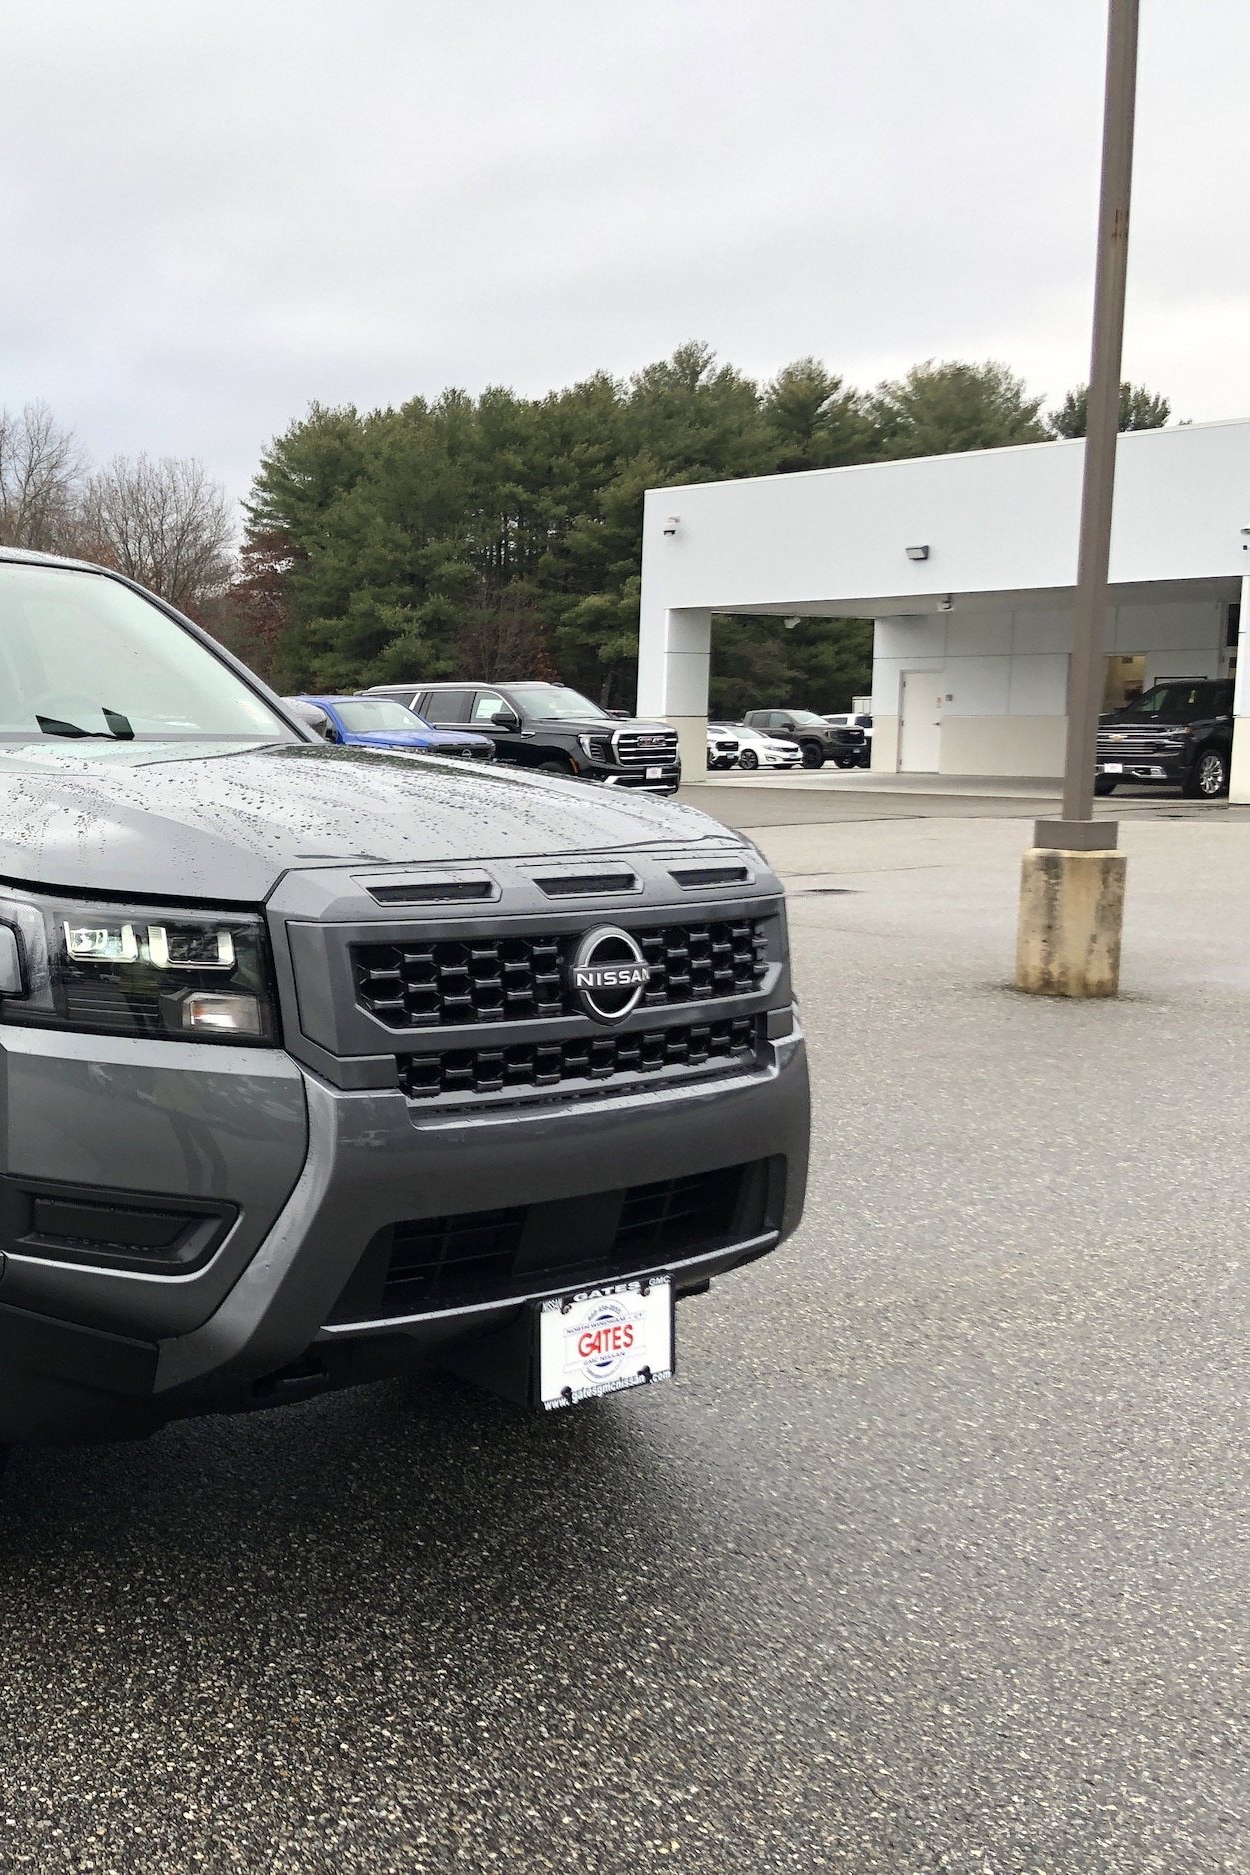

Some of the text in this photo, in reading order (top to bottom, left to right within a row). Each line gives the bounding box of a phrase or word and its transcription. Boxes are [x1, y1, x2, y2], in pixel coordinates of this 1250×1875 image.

[576, 968, 650, 986] NISSAN
[573, 1275, 671, 1301] GATES GMC
[578, 1324, 634, 1357] GATES
